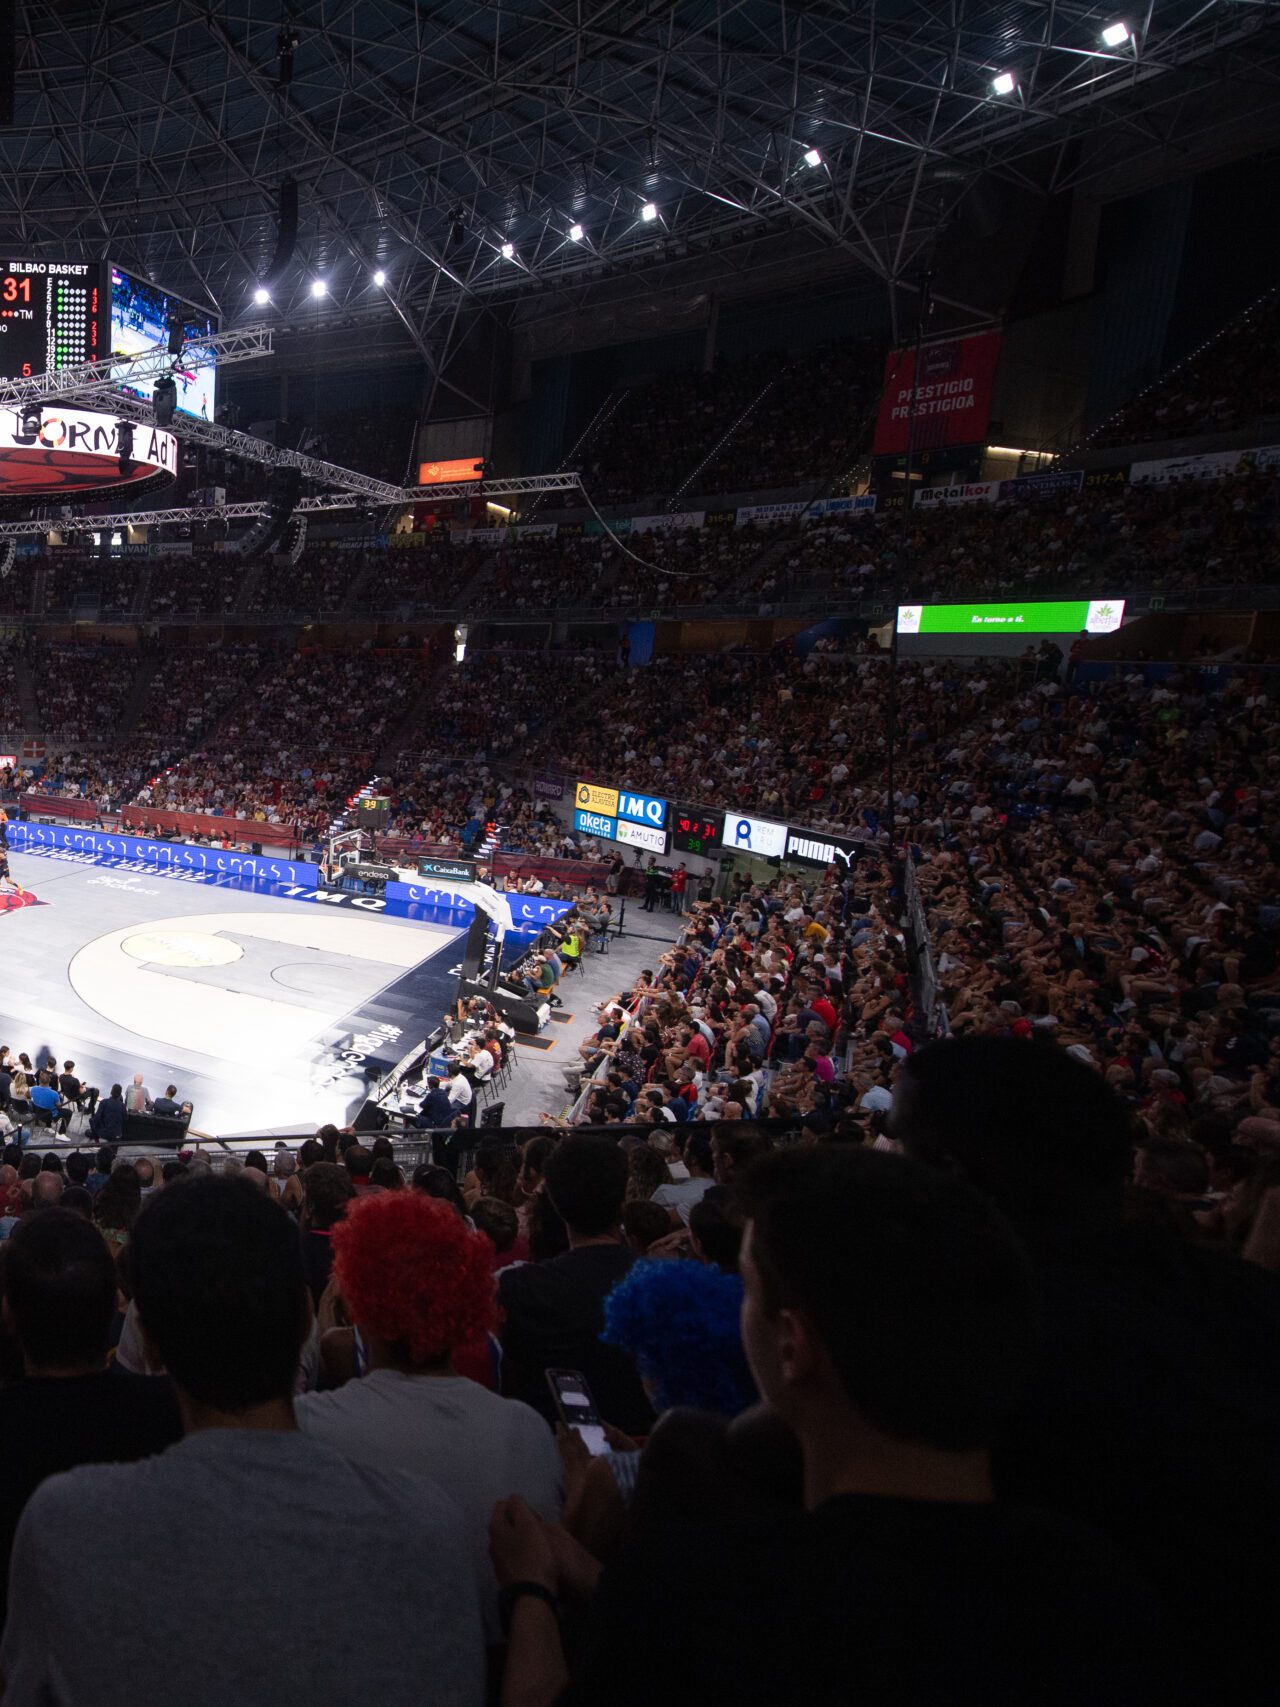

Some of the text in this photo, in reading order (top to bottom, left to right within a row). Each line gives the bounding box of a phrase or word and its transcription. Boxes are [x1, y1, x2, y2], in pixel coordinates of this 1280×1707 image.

[9, 263, 88, 275] BILBAO BASKET
[47, 277, 53, 286] E
[3, 277, 31, 302] 31
[19, 310, 33, 320] TM
[22, 364, 31, 376] 5
[897, 377, 974, 404] PRESTIGIO
[1086, 472, 1125, 486] 317-A
[921, 484, 990, 501] Metalkor
[971, 615, 982, 624] En
[592, 790, 616, 801] ELECTRO
[618, 794, 663, 825] IMQ
[580, 812, 611, 833] oketa
[680, 819, 690, 831] 40
[692, 823, 698, 832] 2
[704, 824, 716, 837] 31
[630, 829, 664, 846] AMUTIO
[788, 836, 836, 864] PUMA
[358, 870, 389, 880] endesa
[433, 865, 470, 877] CaixaBank
[284, 886, 387, 911] IMQ
